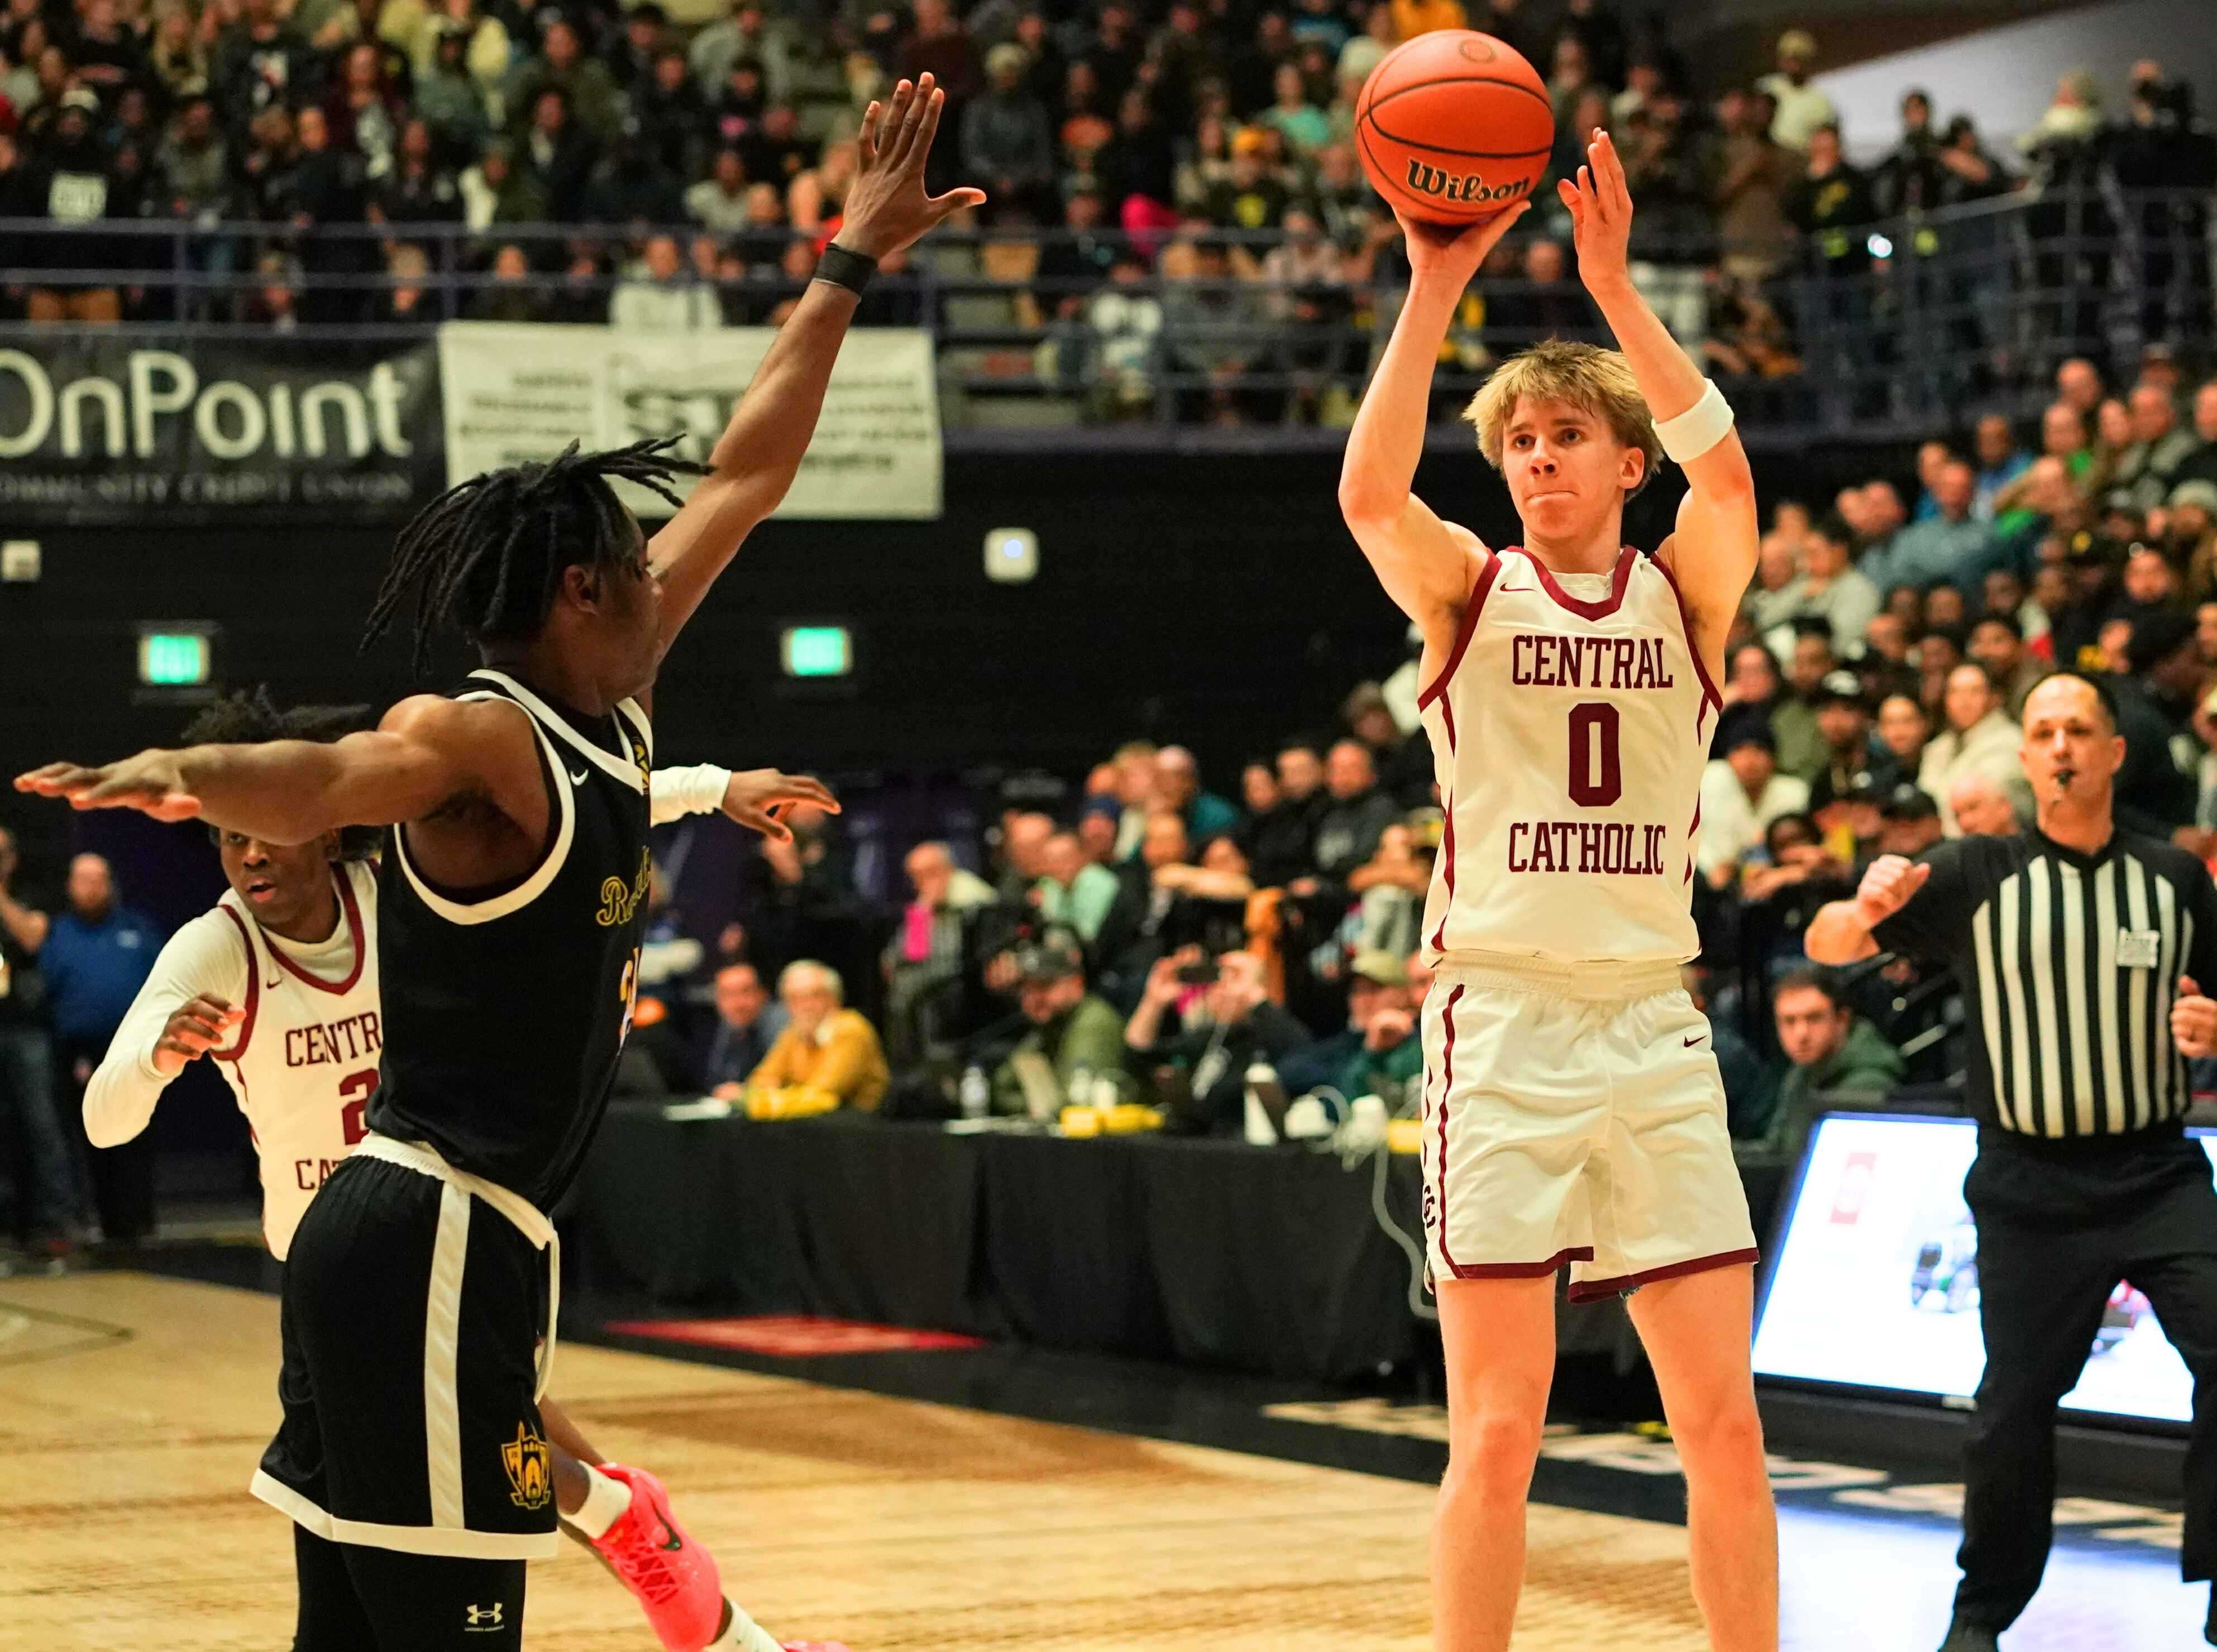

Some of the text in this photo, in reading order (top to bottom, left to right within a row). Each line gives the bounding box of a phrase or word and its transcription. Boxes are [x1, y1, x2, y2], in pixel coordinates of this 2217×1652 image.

[1407, 157, 1530, 203] Wilson
[0, 348, 413, 458] OnPoint
[1513, 636, 1673, 689] CENTRAL
[1569, 702, 1622, 807] 0
[1509, 822, 1666, 875] CATHOLIC
[285, 1012, 382, 1067] CENTR
[338, 1067, 380, 1146] 2
[295, 1158, 341, 1191] CA
